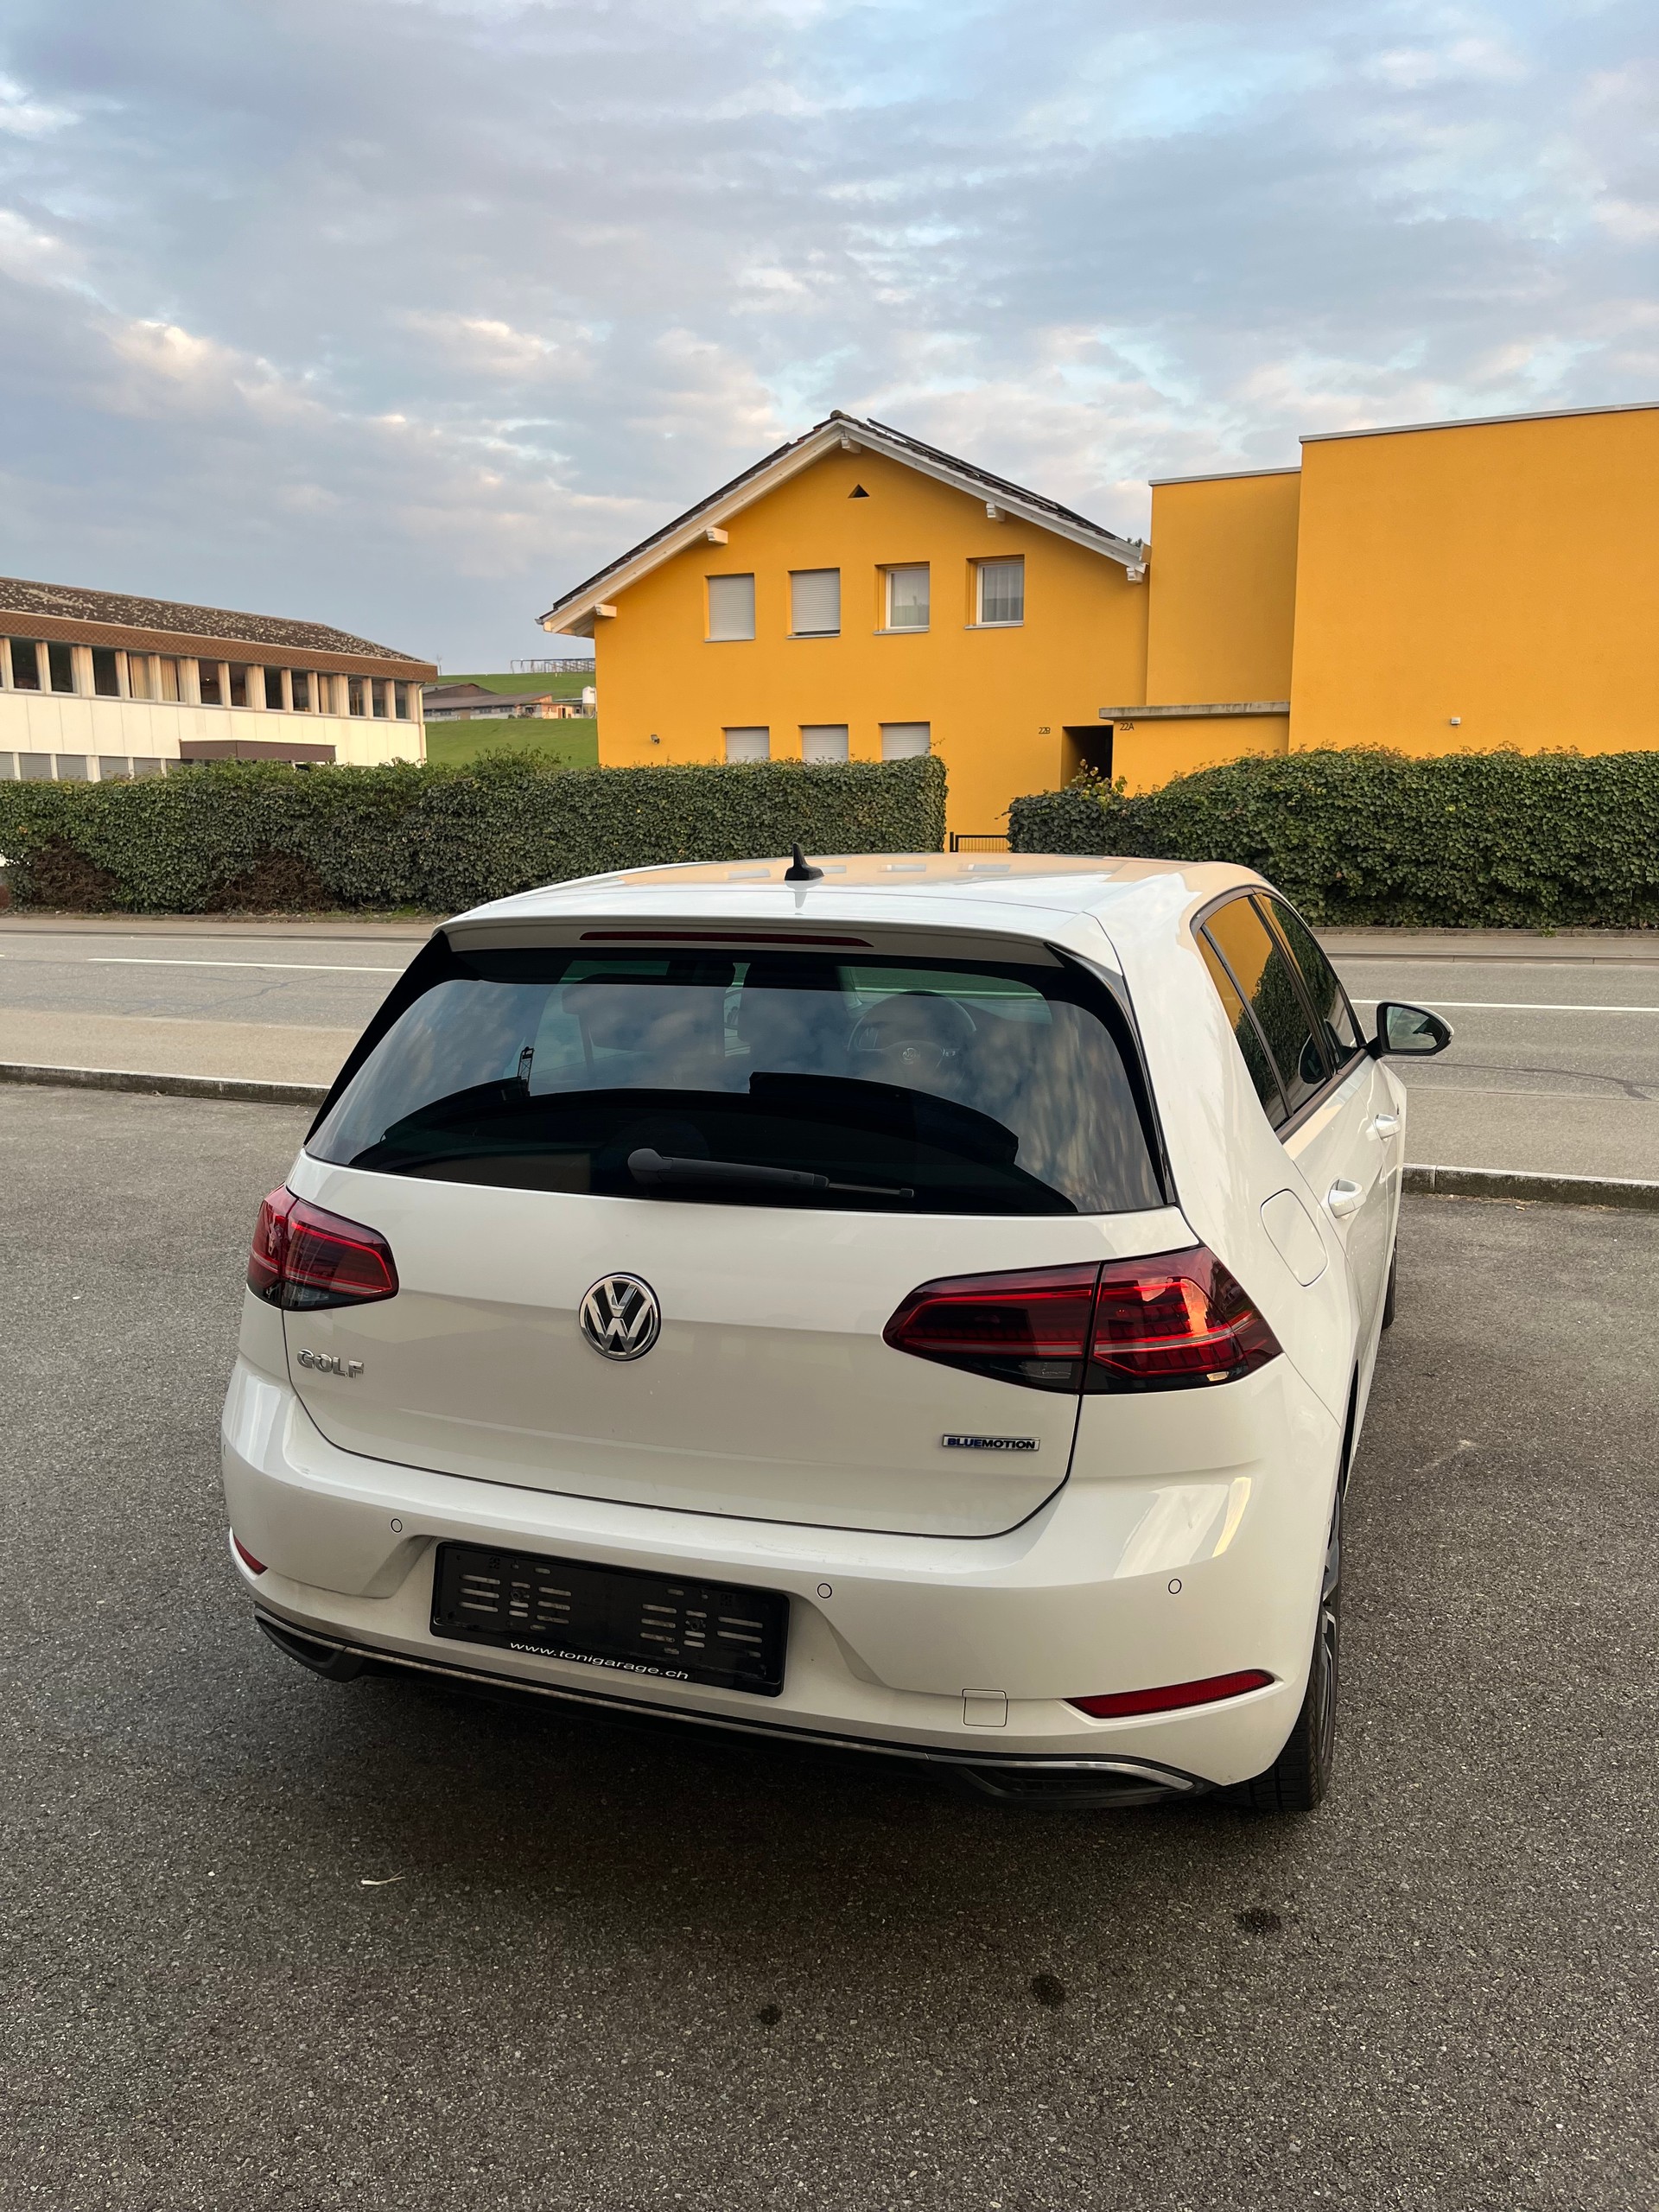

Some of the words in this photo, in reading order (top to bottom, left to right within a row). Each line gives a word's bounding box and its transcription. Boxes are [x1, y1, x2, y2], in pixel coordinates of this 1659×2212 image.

[1119, 722, 1134, 731] 22A
[296, 1349, 364, 1379] GOLF
[947, 1437, 1036, 1449] BLUEMOTION
[510, 1642, 689, 1680] www.tonigarage.ch
